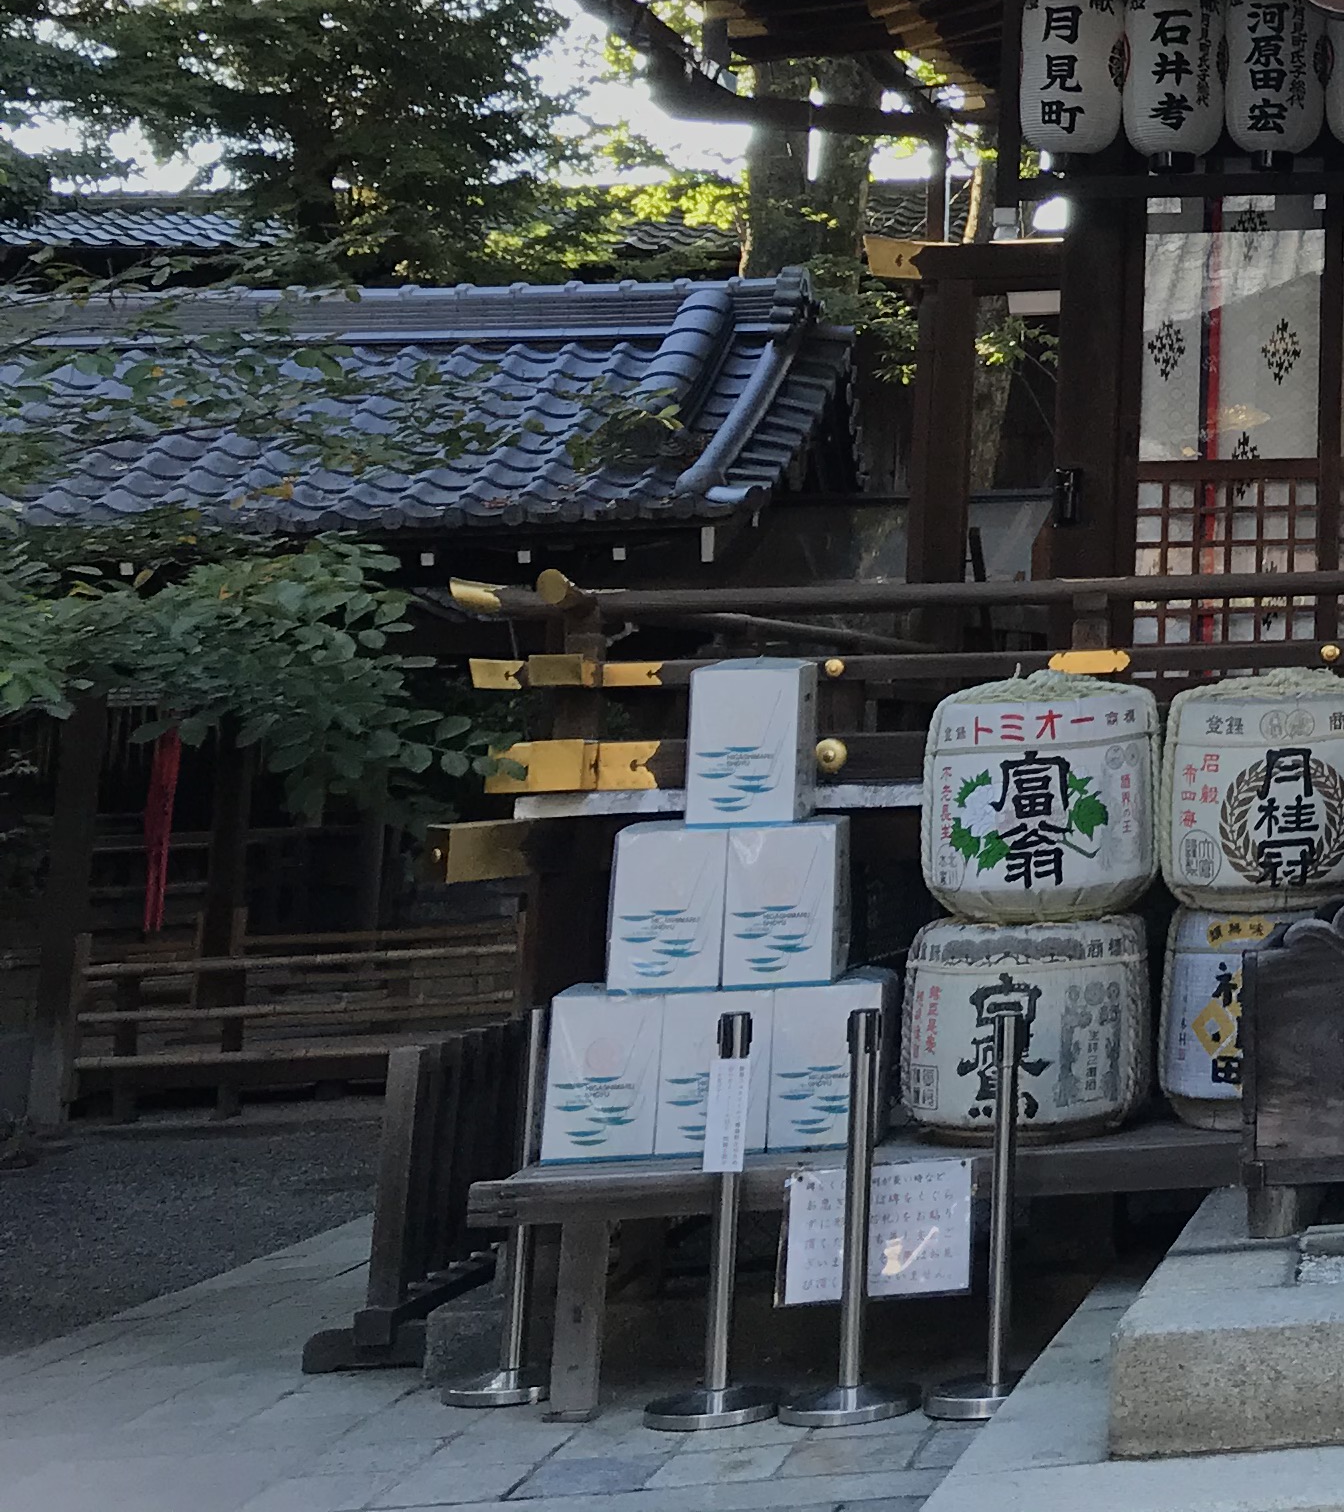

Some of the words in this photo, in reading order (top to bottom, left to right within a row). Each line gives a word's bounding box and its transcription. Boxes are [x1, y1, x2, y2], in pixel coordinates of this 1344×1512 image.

[1040, 5, 1085, 134] 月見町
[1243, 2, 1288, 134] 河原田宏
[974, 709, 1095, 744] トミオー
[1205, 714, 1244, 736] 登録
[990, 750, 1074, 889] 富翁
[1254, 747, 1320, 888] 月桂冠
